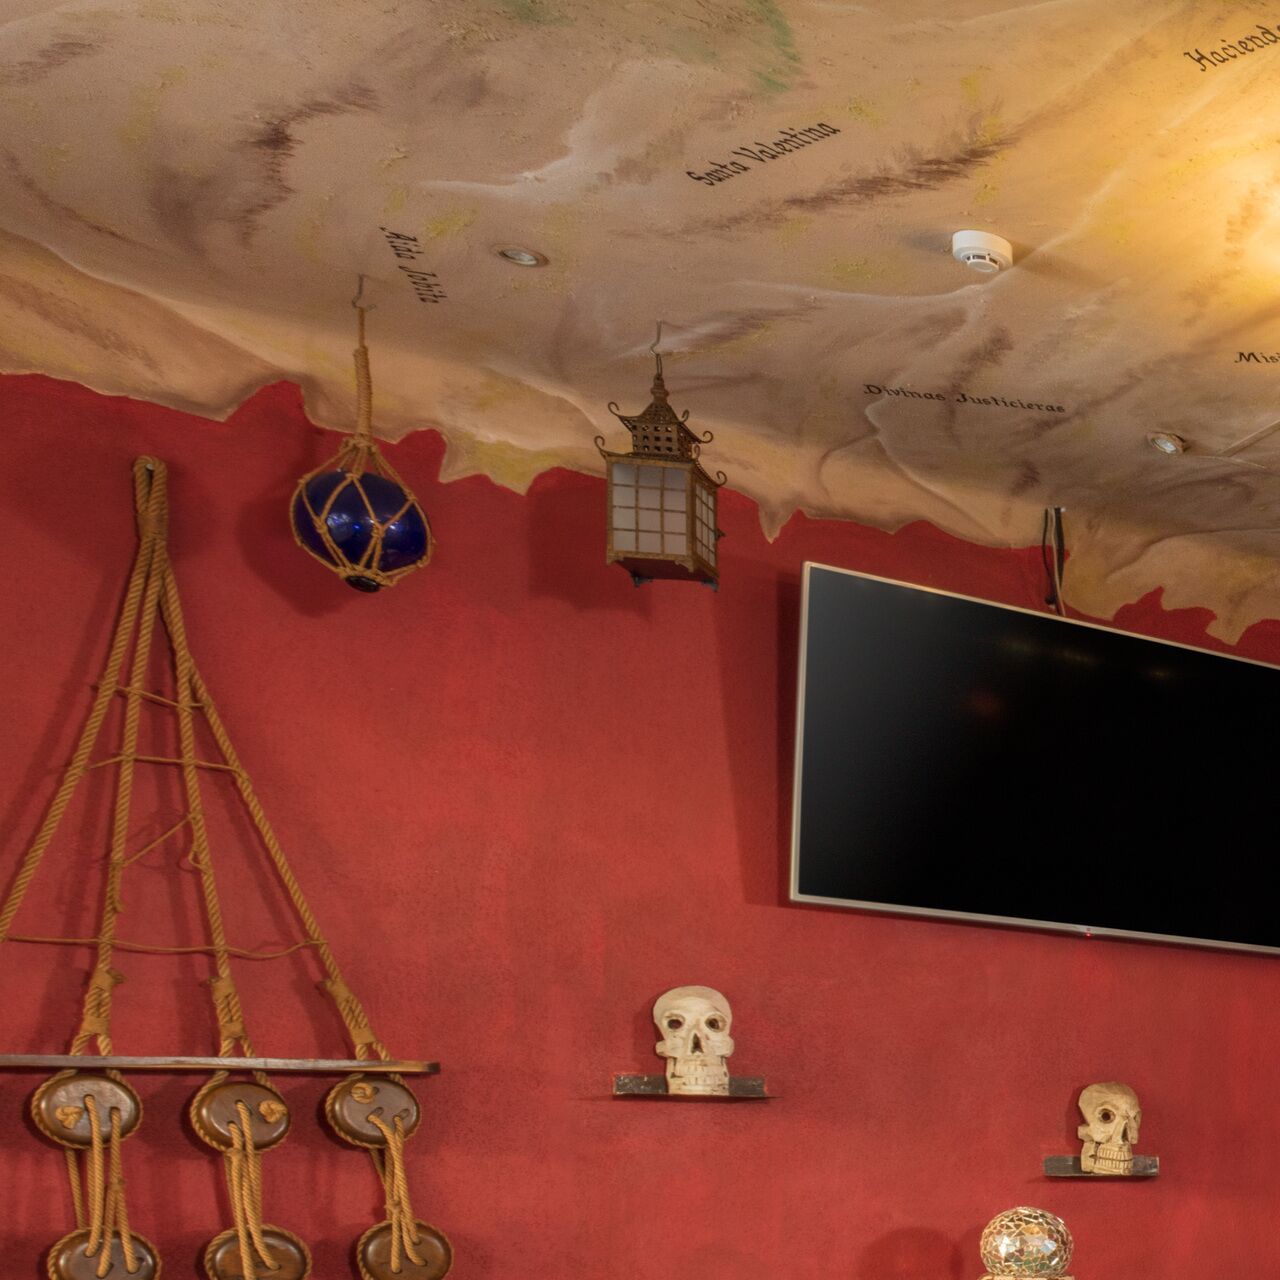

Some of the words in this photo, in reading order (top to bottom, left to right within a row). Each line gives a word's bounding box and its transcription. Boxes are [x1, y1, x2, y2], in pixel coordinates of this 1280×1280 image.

[685, 159, 751, 186] Santa
[731, 122, 841, 163] Valentina
[863, 383, 946, 402] Divinas
[956, 392, 1066, 414] Justicieras
